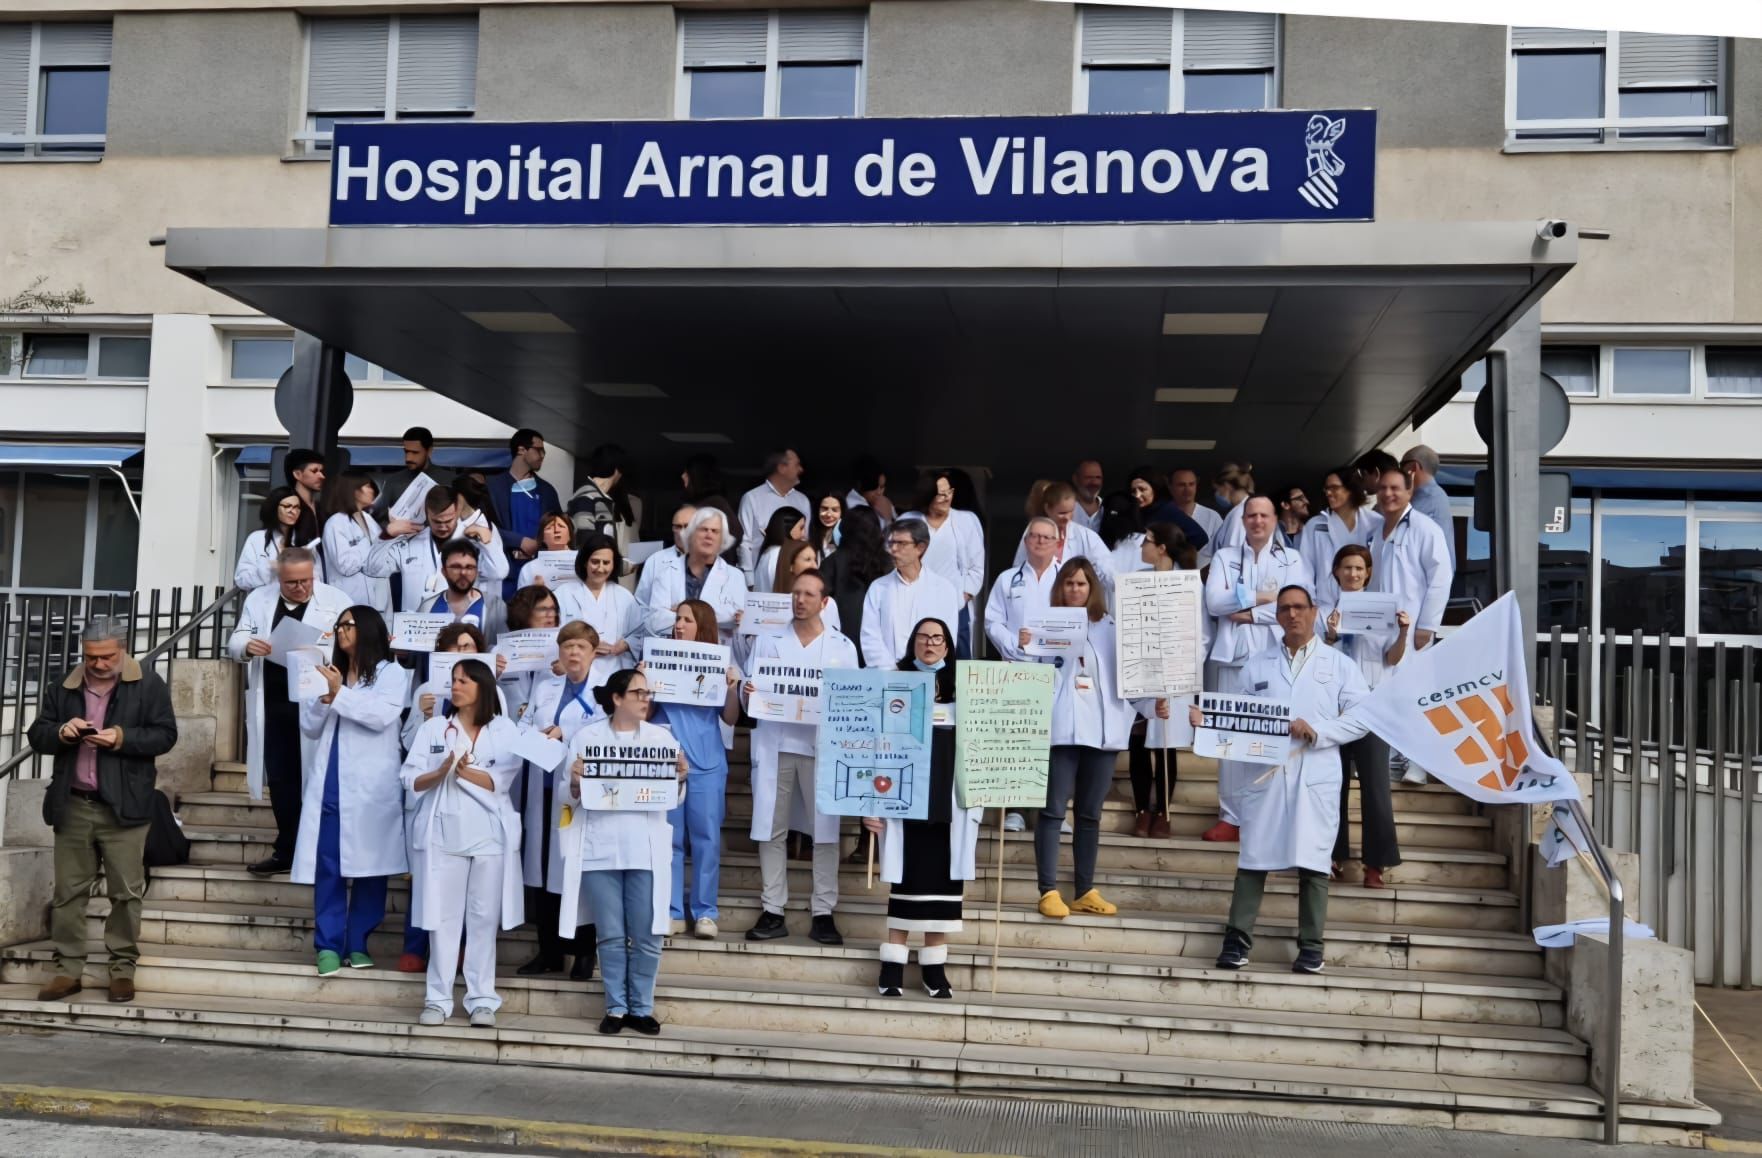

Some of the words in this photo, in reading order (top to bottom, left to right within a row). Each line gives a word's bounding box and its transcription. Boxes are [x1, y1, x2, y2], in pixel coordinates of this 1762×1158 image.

[337, 143, 602, 216] Hospital
[623, 142, 828, 199] Arnau
[854, 138, 936, 198] de
[959, 136, 1269, 197] Vilanova
[1417, 669, 1503, 707] cesmcv
[1202, 698, 1217, 710] NO
[1220, 699, 1232, 711] ES
[1234, 701, 1290, 717] VOCACIÓN
[585, 745, 601, 757] NO
[603, 745, 617, 758] ES
[619, 745, 677, 760] VOCACIÓN
